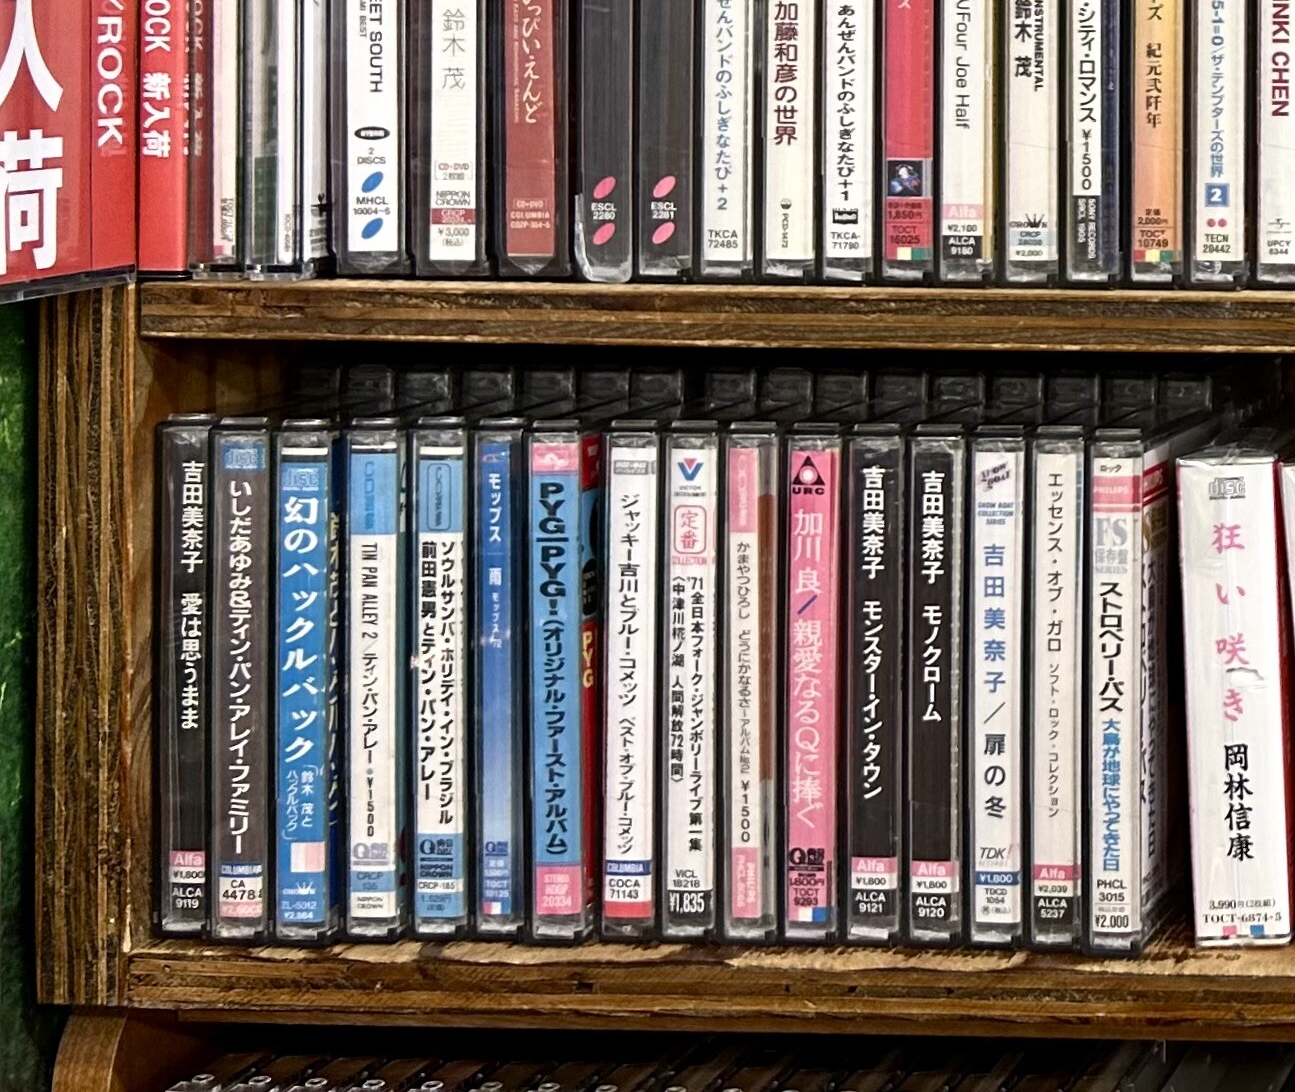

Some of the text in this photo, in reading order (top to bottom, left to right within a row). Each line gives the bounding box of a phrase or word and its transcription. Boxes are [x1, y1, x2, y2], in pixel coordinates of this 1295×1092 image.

[370, 31, 383, 92] SOUTH
[773, 1, 799, 146] 加藤和彦の世界
[1270, 52, 1290, 118] CHEN
[142, 72, 171, 159] 新入荷
[651, 201, 677, 211] ESCL
[948, 237, 976, 246] ALCA
[487, 473, 501, 542] モップス
[791, 486, 825, 495] URC
[180, 460, 204, 730] 吉田美奈子 愛は思うまま
[361, 543, 378, 626] TIN PAN ALLEY
[1046, 473, 1064, 653] エッセンス・オブ・ガロ
[281, 496, 319, 764] 幻のハックルバック
[861, 467, 885, 800] 吉田美奈子 モンスター・イン・タウン
[922, 604, 944, 723] モノクローム
[1212, 522, 1254, 860] 狂い咲き 岡林信康
[983, 734, 1007, 819] 扉の冬
[608, 879, 640, 889] COCA
